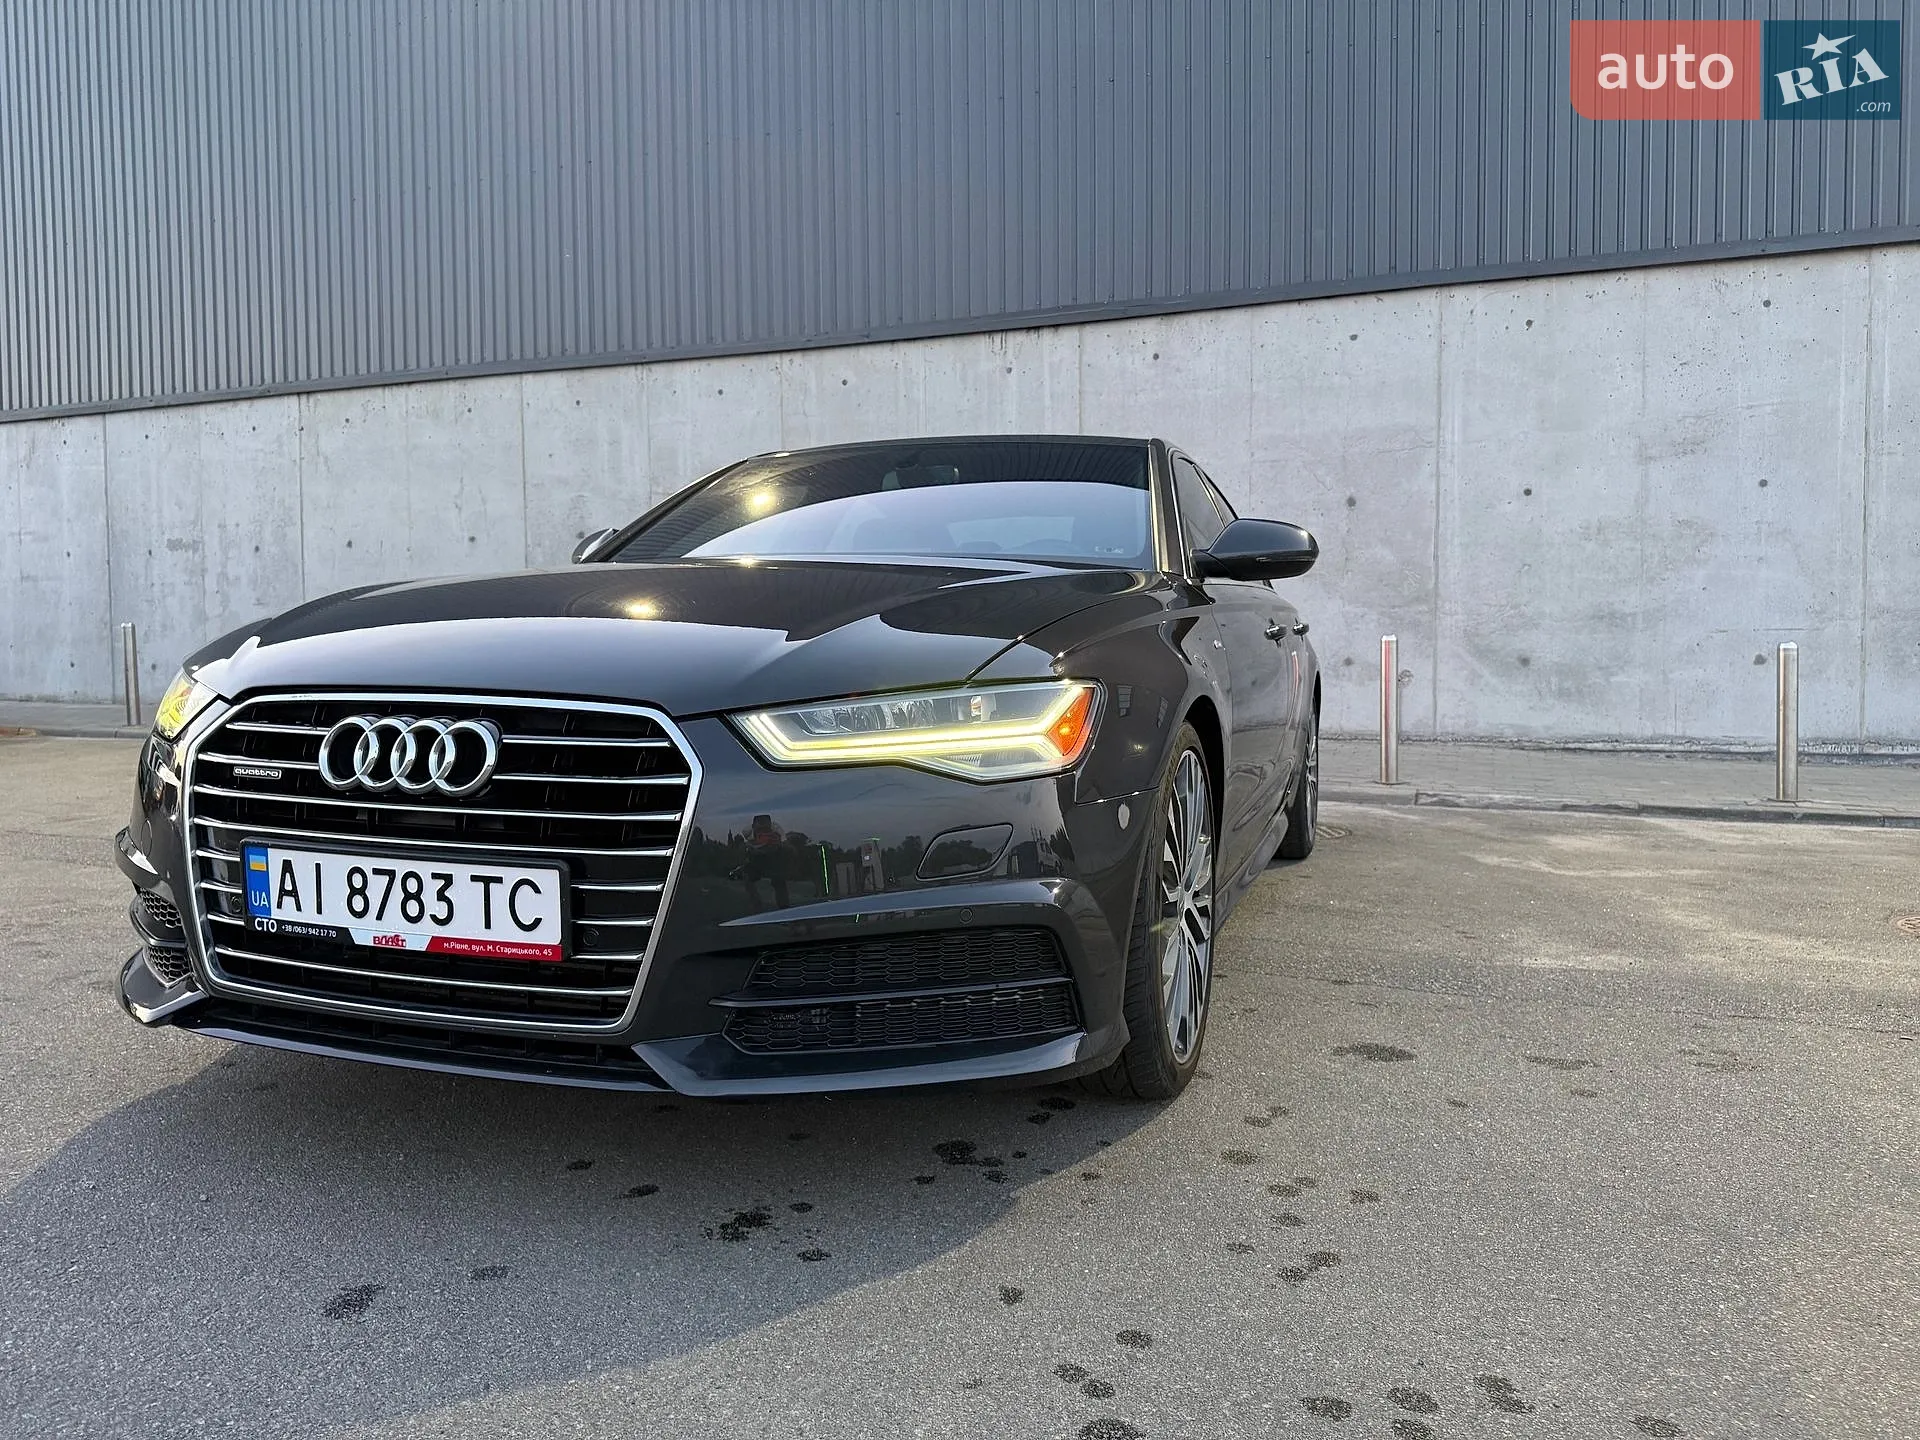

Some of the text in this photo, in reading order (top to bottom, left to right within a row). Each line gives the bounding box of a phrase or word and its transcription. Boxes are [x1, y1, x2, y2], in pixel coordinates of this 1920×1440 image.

[234, 767, 279, 778] quattro
[251, 890, 269, 908] UA
[276, 858, 543, 932] AI 8783 TC
[254, 917, 278, 933] СТО
[471, 944, 486, 952] вул.
[495, 945, 542, 956] Старицького,
[542, 948, 553, 956] 45
